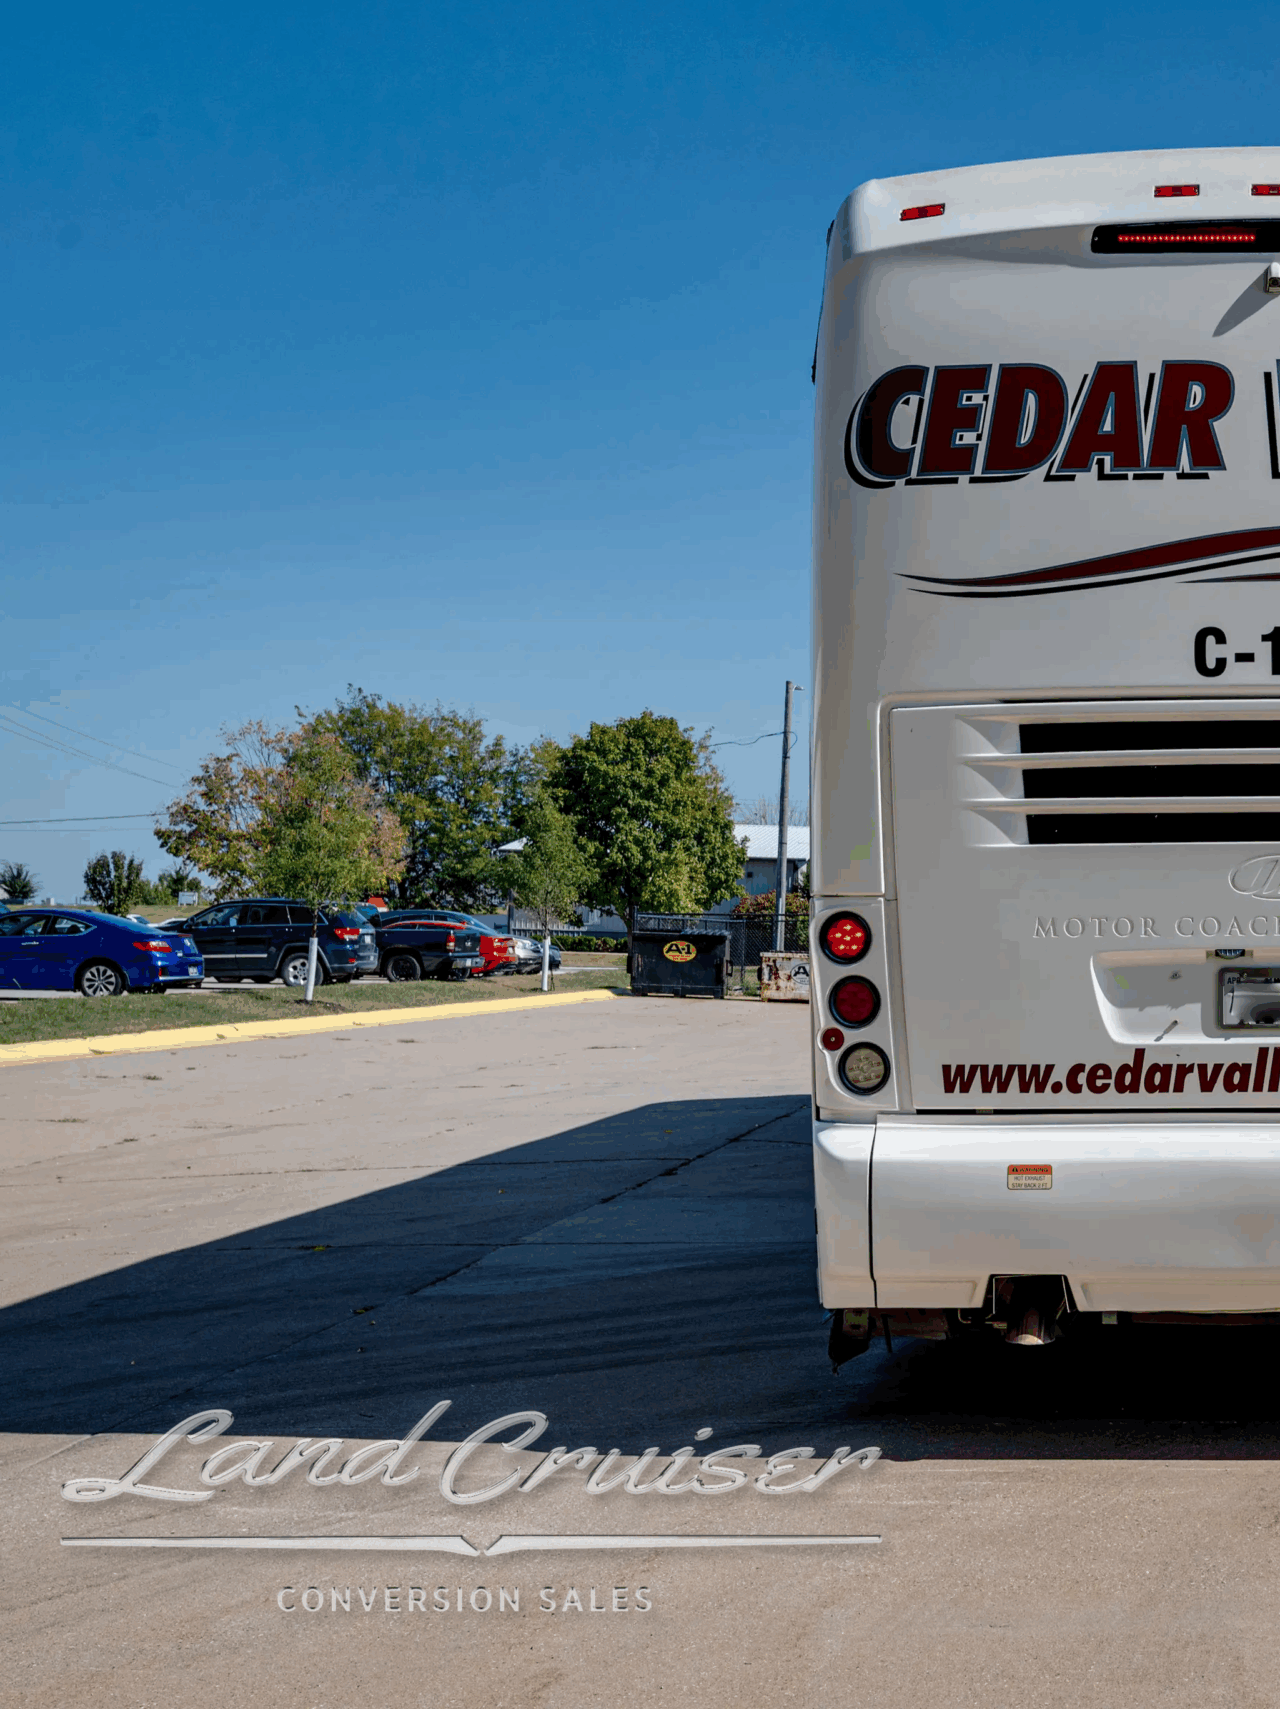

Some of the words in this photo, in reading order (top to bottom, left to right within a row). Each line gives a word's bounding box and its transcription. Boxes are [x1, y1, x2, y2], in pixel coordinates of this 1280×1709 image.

[844, 360, 1236, 489] CEDAR
[1032, 916, 1161, 938] MOTOR
[664, 943, 693, 955] A-1
